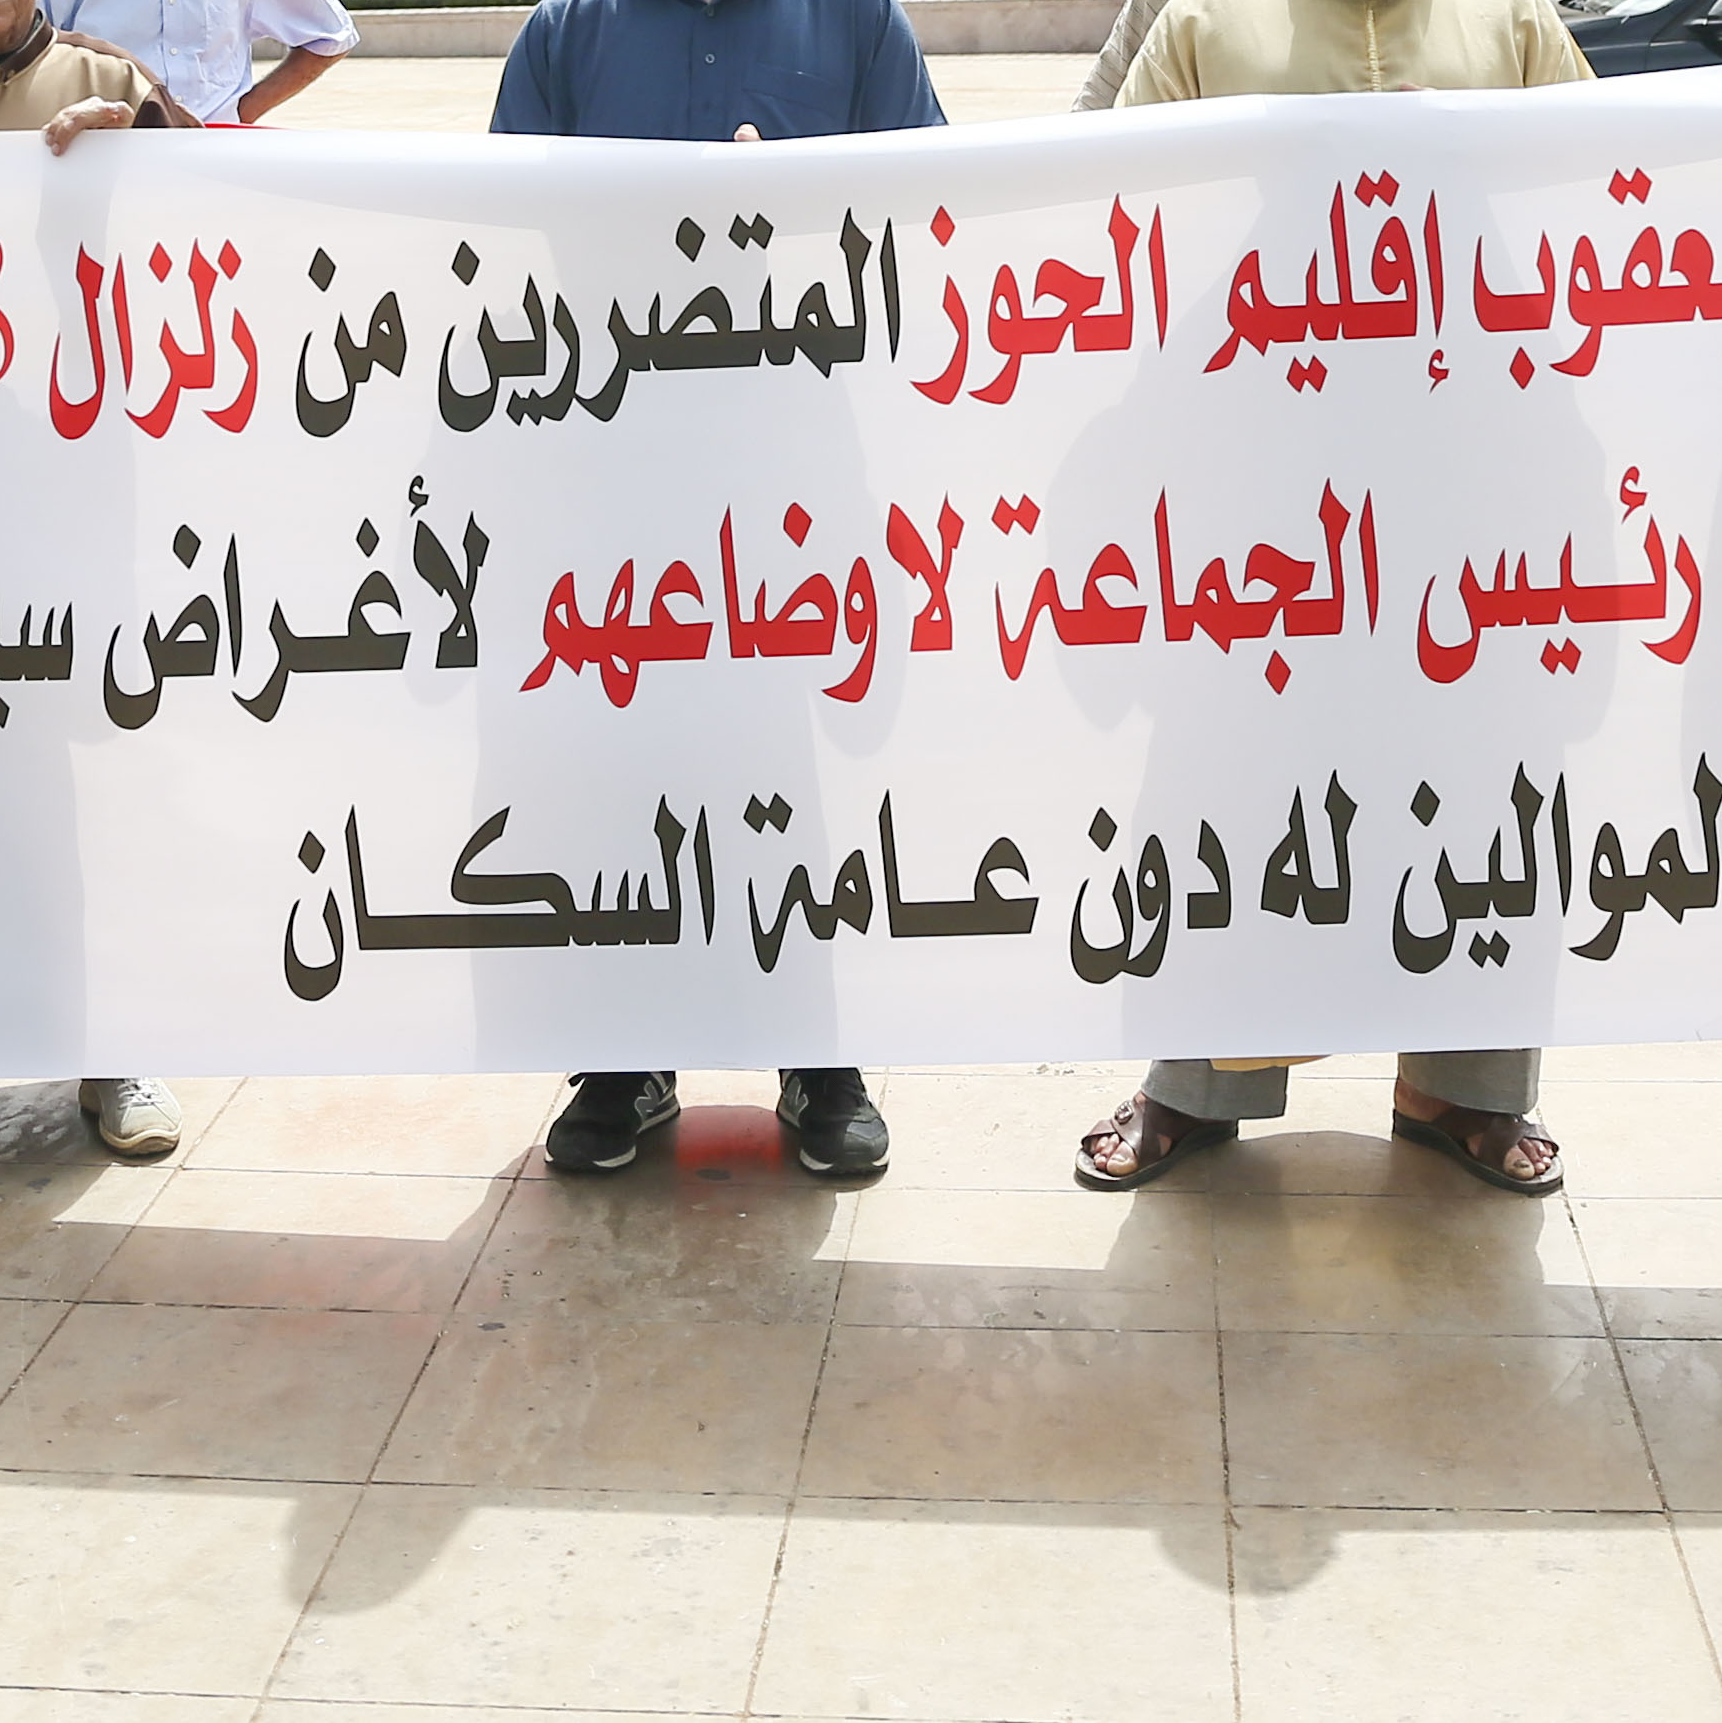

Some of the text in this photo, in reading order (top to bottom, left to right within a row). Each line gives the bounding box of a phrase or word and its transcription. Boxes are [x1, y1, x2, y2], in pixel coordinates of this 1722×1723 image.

[49, 238, 258, 440] زلزال
[295, 247, 407, 438] من
[438, 207, 901, 433] المتضررين
[910, 194, 1168, 405] الحوز
[1203, 170, 1444, 393] إقليم
[103, 475, 490, 731] لأغراض
[519, 492, 964, 709] لاوضاعهم
[991, 478, 1379, 695] الجماعة
[1417, 466, 1702, 684] رئيس
[283, 793, 715, 1002] السكان
[742, 789, 1040, 974] عامة
[1070, 807, 1232, 985] دون
[1260, 769, 1358, 926] له
